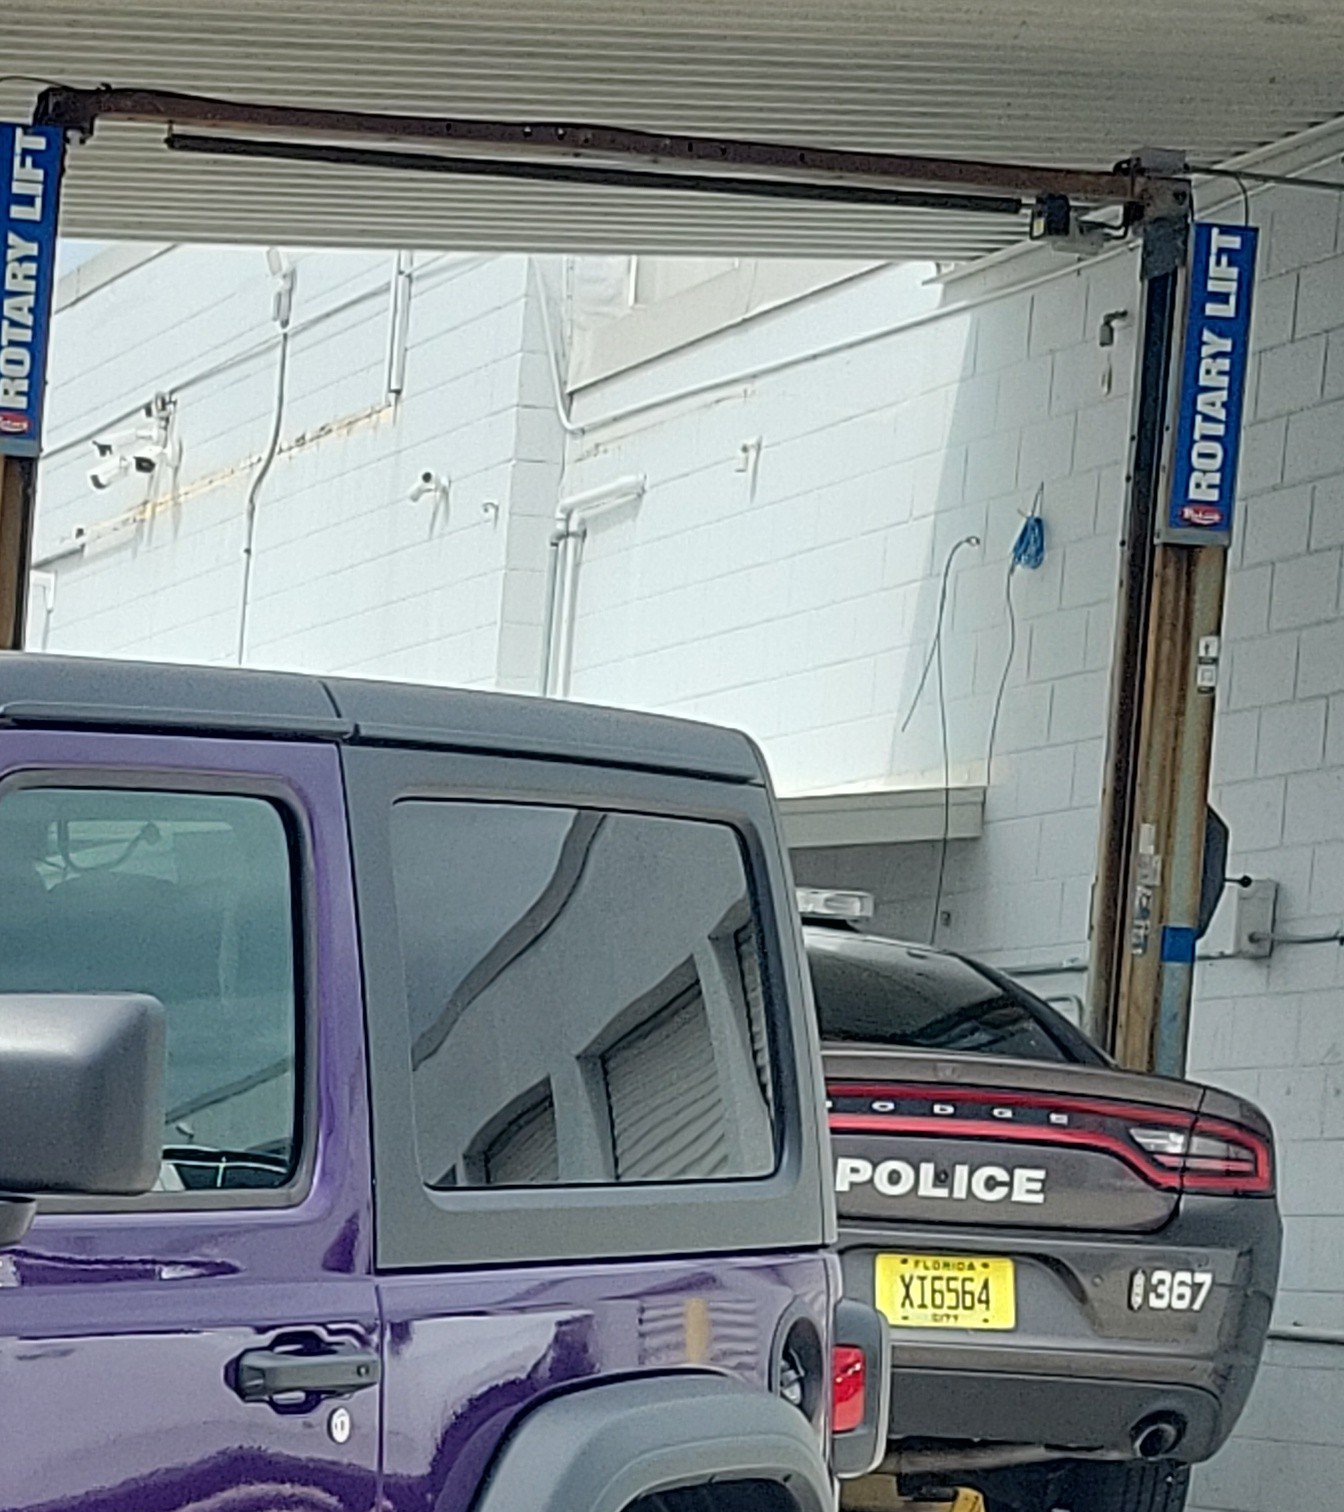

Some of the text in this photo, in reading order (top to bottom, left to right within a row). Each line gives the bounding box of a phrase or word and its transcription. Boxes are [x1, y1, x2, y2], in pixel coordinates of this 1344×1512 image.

[9, 126, 48, 223] LIFT
[1204, 227, 1242, 319] LIFT
[1188, 328, 1233, 502] ROTARY
[834, 1156, 1047, 1204] POLICE
[913, 1259, 977, 1271] FLORIDA
[899, 1274, 991, 1311] XI6564
[1148, 1269, 1213, 1311] 367
